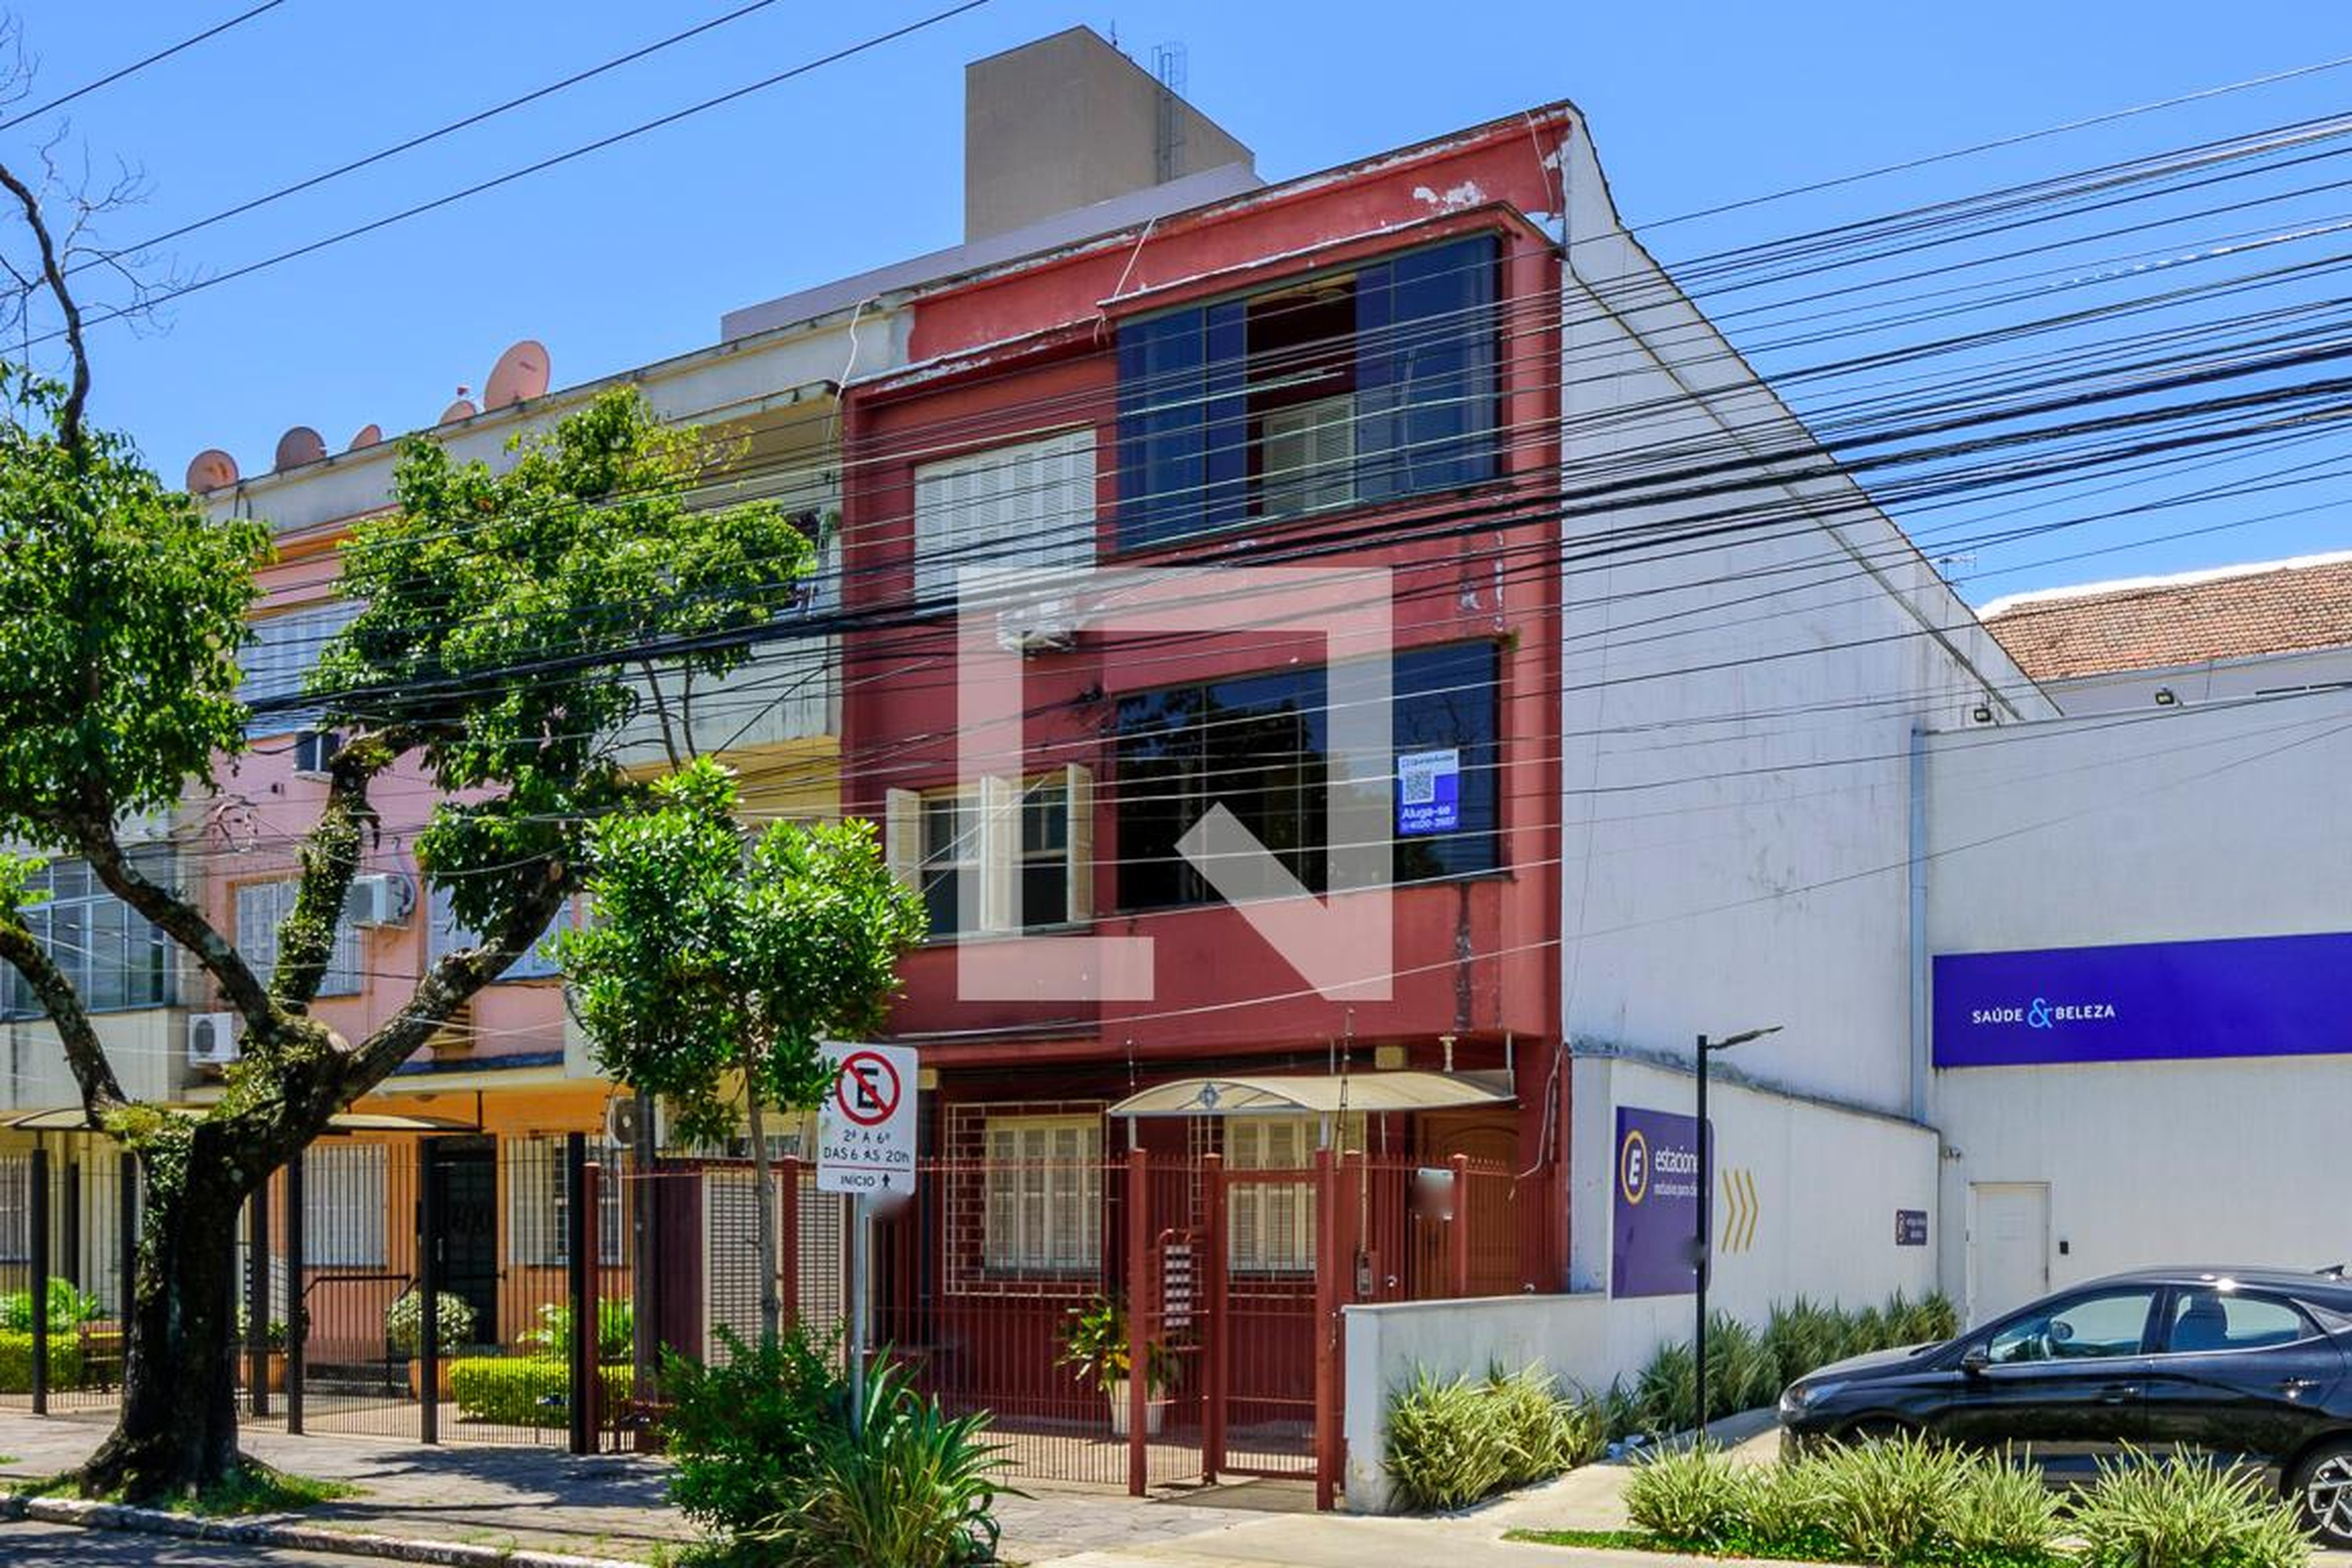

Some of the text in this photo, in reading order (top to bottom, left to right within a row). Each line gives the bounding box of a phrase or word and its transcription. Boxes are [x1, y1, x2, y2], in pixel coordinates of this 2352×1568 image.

[1972, 997, 2116, 1028] SAÚDE & BELEZA
[862, 1132, 870, 1144] A
[824, 1147, 848, 1160] DAS
[850, 1149, 858, 1161] 6
[1629, 1148, 1642, 1186] E
[1655, 1145, 1697, 1174] estacion
